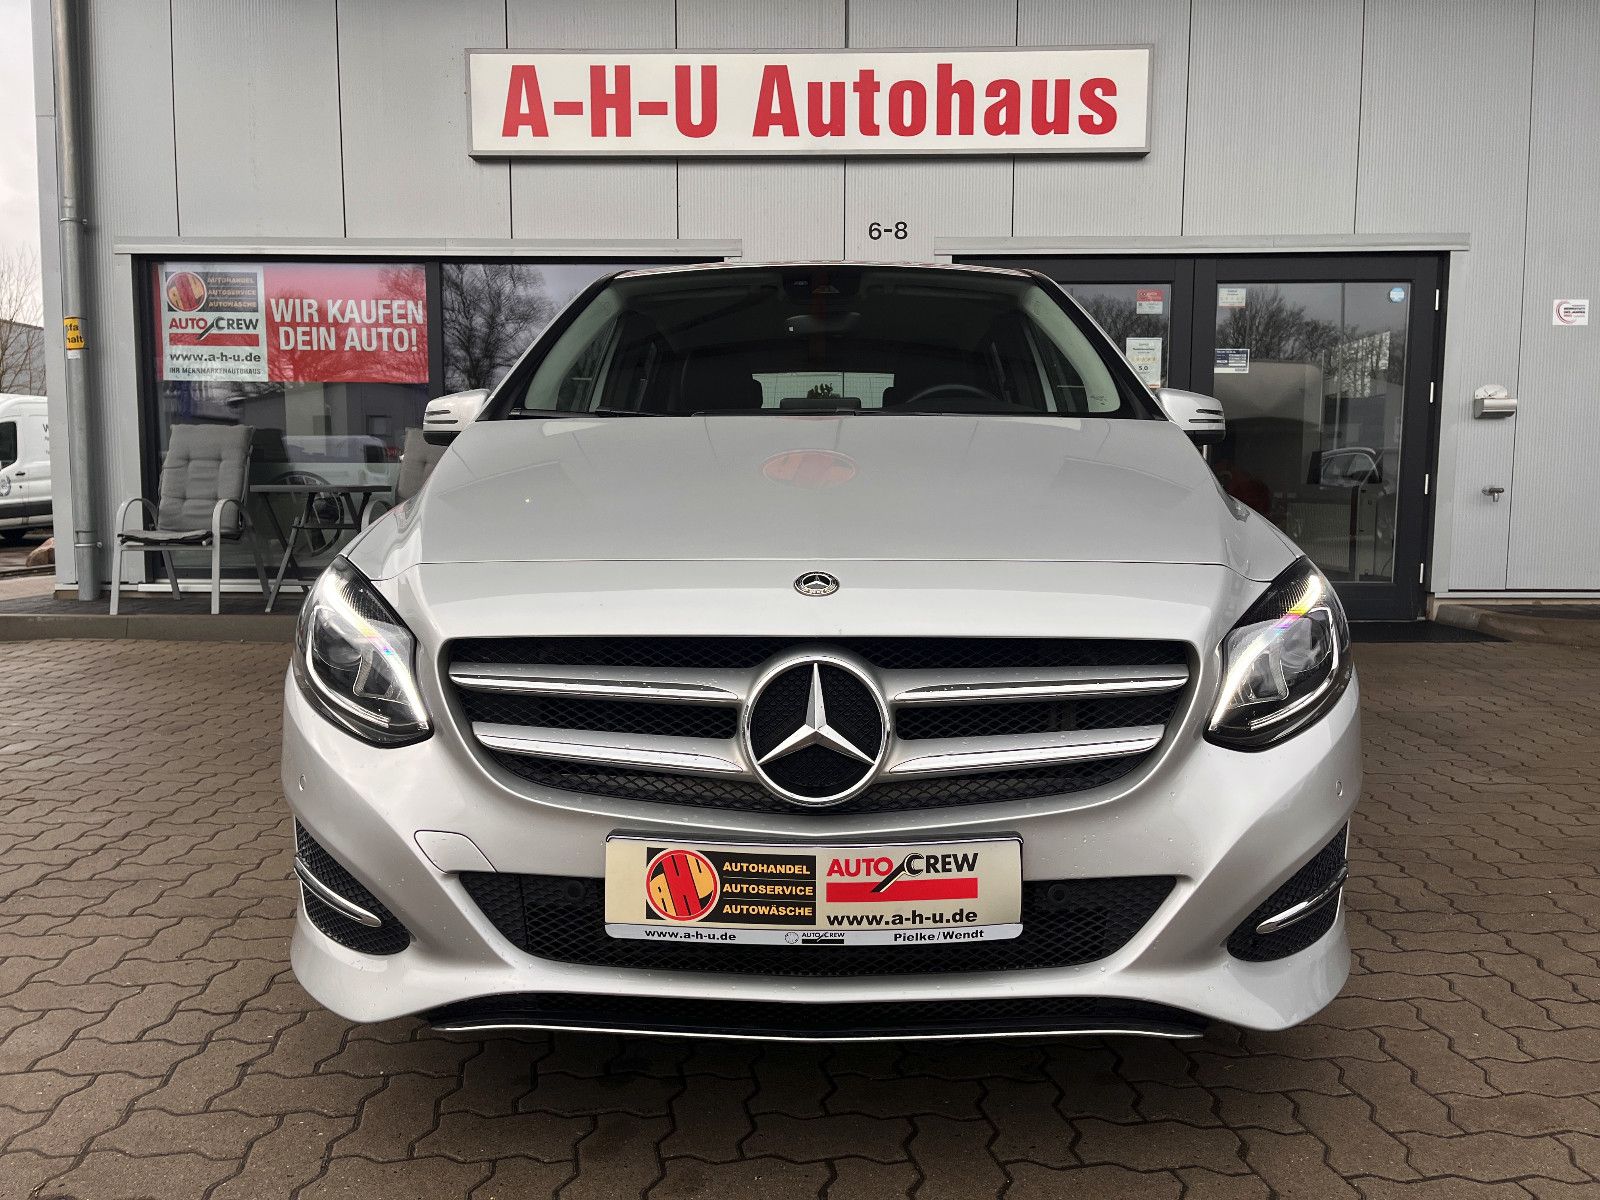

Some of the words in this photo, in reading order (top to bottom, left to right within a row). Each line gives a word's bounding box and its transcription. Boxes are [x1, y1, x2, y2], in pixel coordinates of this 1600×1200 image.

[502, 64, 718, 139] A-H-U
[752, 63, 1117, 138] Autohaus
[868, 221, 908, 241] 6-8
[207, 276, 255, 284] AUTOHANDEL
[270, 298, 319, 323] WIR
[327, 299, 424, 325] KAUFEN
[169, 317, 208, 330] AUTO
[215, 316, 259, 330] CREW
[278, 326, 336, 351] DEIN
[344, 327, 418, 352] AUTO!
[169, 352, 261, 362] www.a-h-u.de
[722, 861, 811, 875] AUTOHANDEL
[826, 856, 894, 877] AUTO
[905, 852, 979, 877] CREW
[722, 883, 814, 896] AUTOSERVICE
[722, 903, 813, 916] AUTOWÄSCHE
[826, 908, 978, 926] www.a-h-u.de
[644, 929, 737, 941] www.a-h-u.de
[893, 929, 985, 942] Pielke/Wendt
